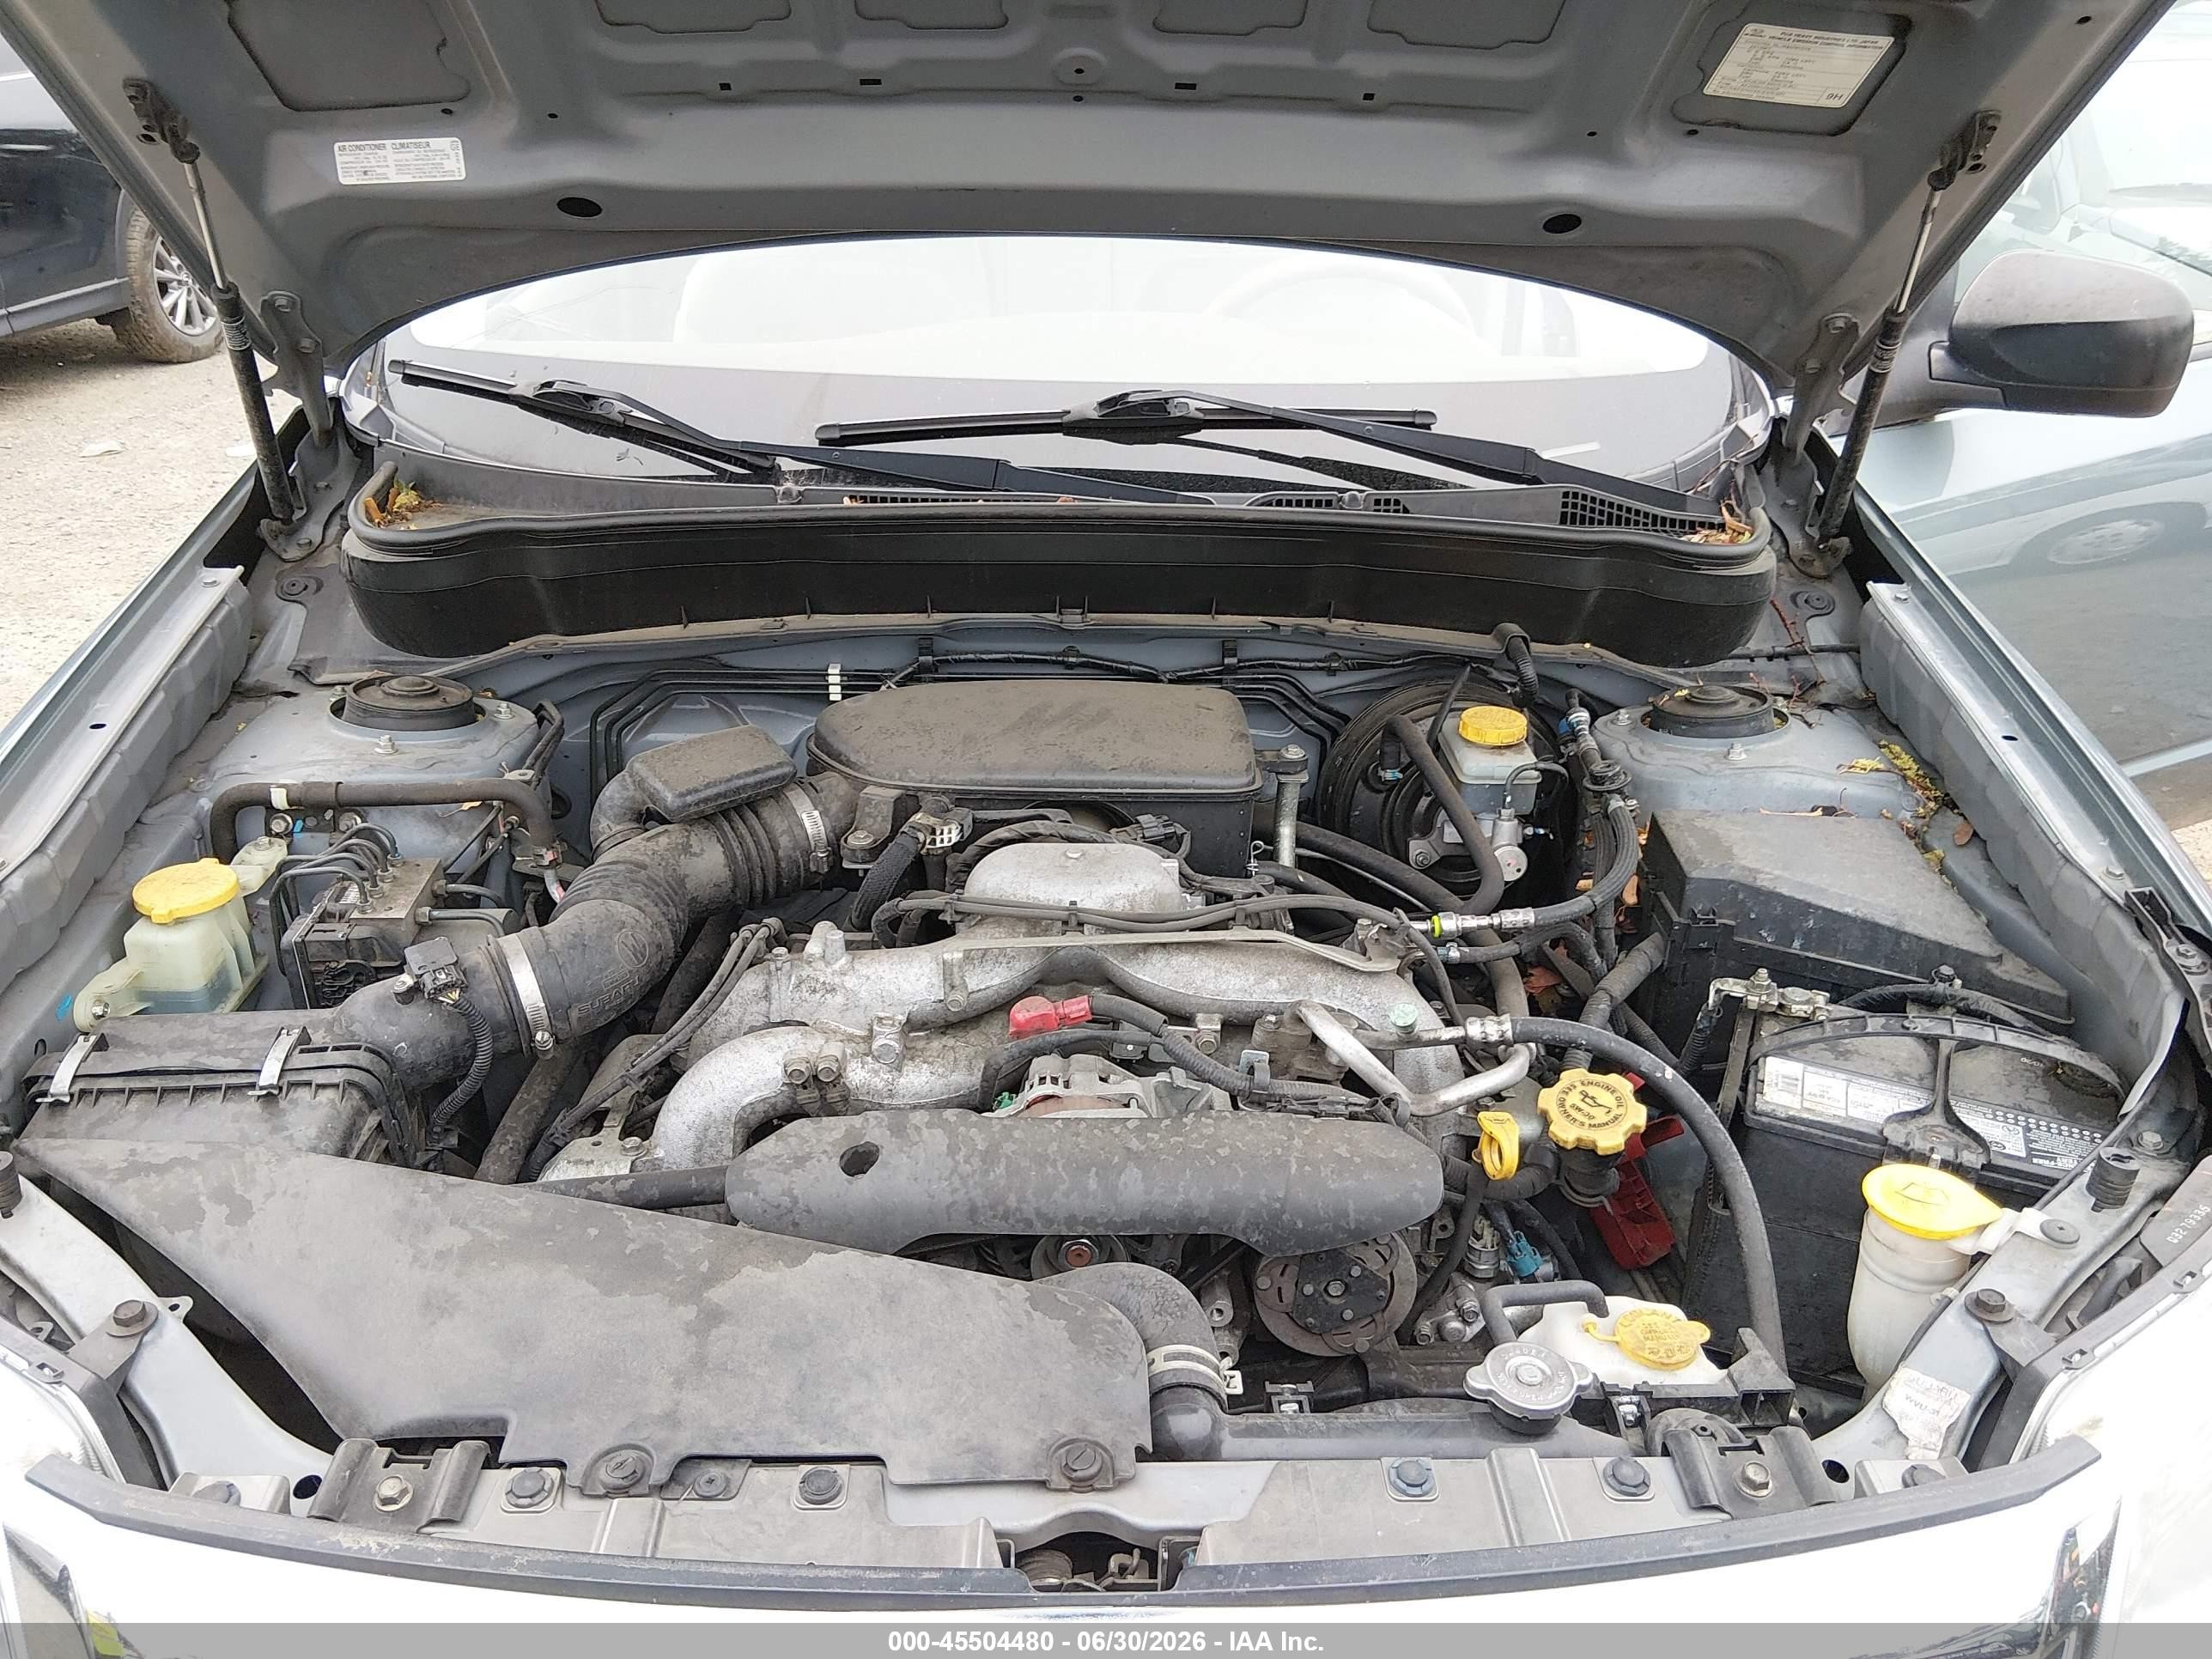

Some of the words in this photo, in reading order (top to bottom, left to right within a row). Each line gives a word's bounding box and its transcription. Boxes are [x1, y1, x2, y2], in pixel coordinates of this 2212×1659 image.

[348, 143, 386, 151] CONDITIONER
[391, 141, 431, 149] CLIMATISEUR
[1562, 1083, 1577, 1097] SEE
[1581, 1081, 1616, 1095] ENGINE
[1615, 1096, 1625, 1108] OIL
[1559, 1097, 1586, 1127] OWNER'S
[1569, 1103, 1595, 1121] 5W-30
[1589, 1114, 1622, 1127] MANUAL
